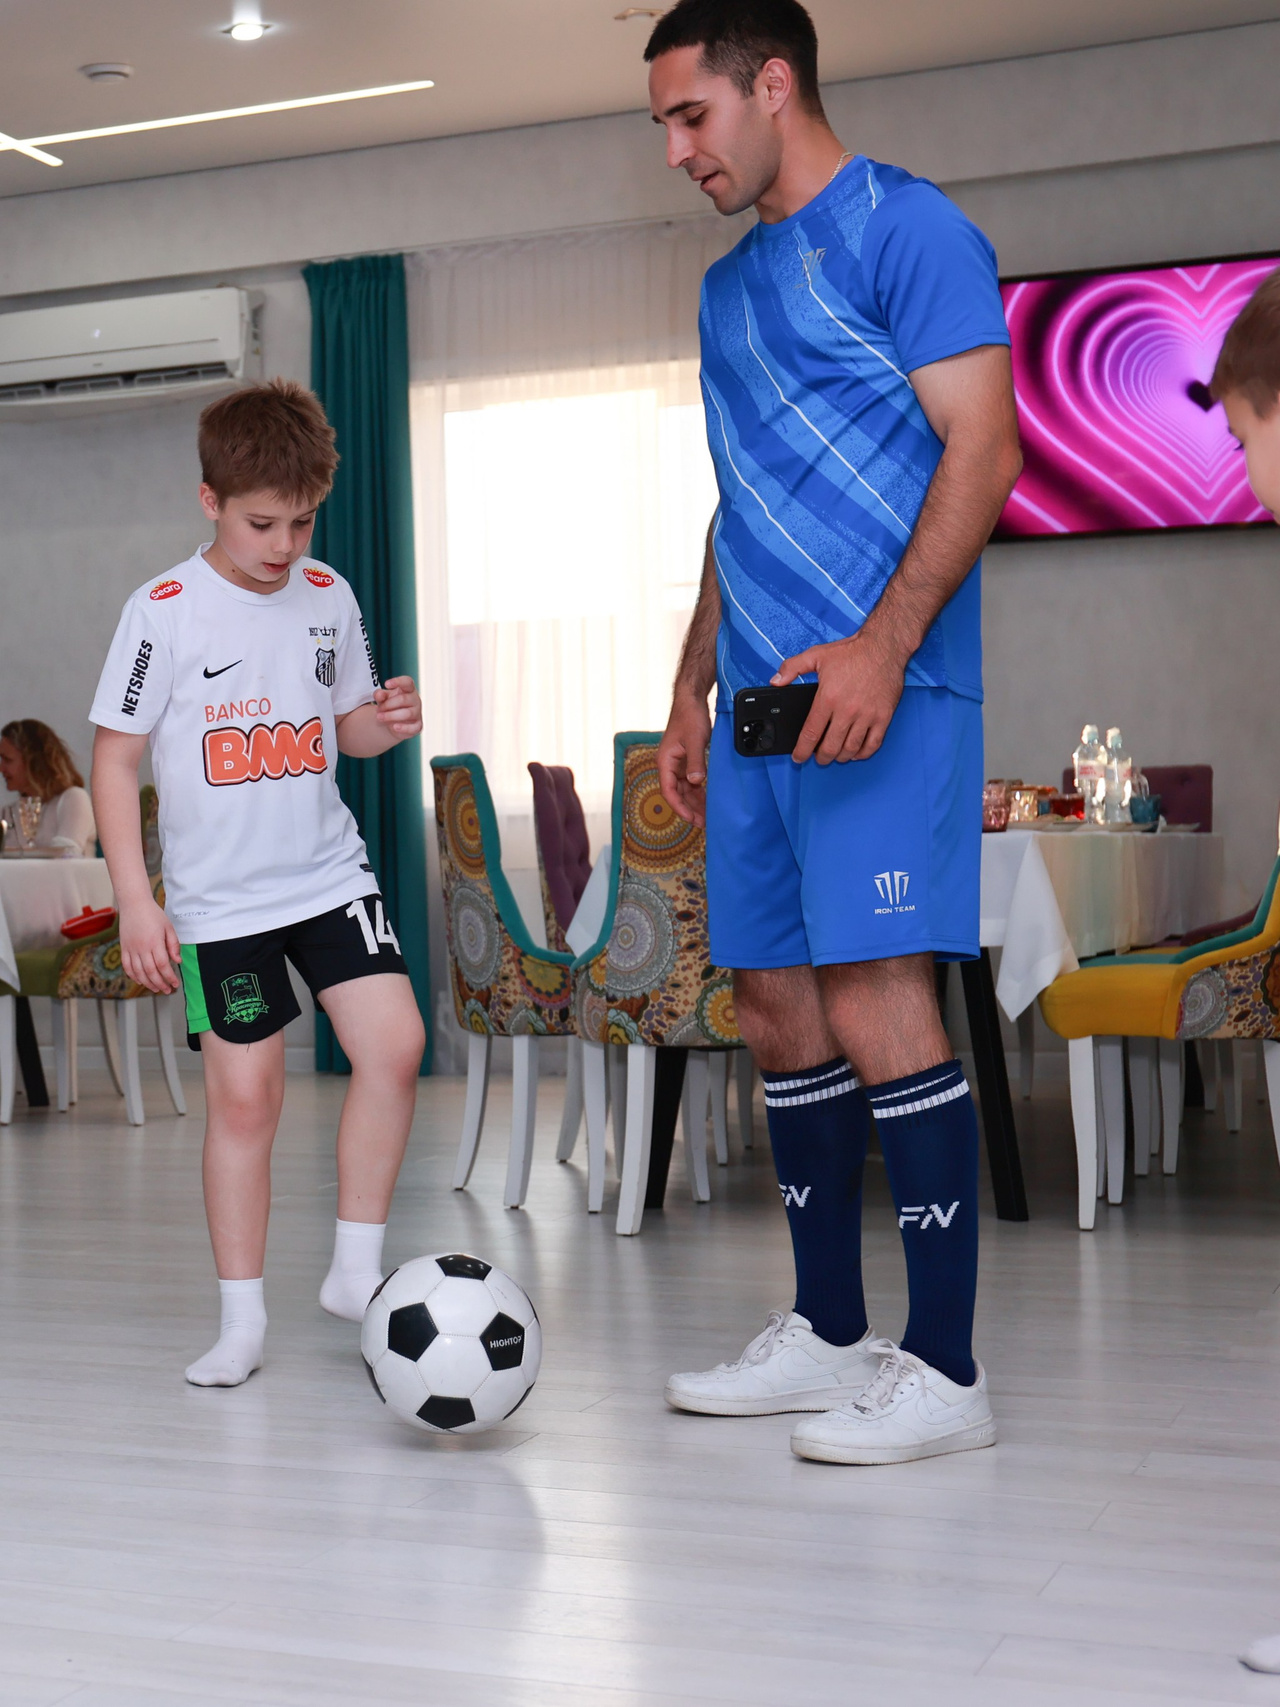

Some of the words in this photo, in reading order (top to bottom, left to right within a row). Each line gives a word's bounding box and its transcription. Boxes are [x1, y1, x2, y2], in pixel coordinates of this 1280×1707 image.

[304, 569, 332, 584] Seara
[151, 584, 181, 600] Seara
[122, 640, 153, 716] NETSHOES
[204, 698, 272, 724] BANCO
[894, 905, 915, 913] TEAM
[345, 900, 403, 956] 14
[489, 1336, 522, 1349] HIGHTOP
